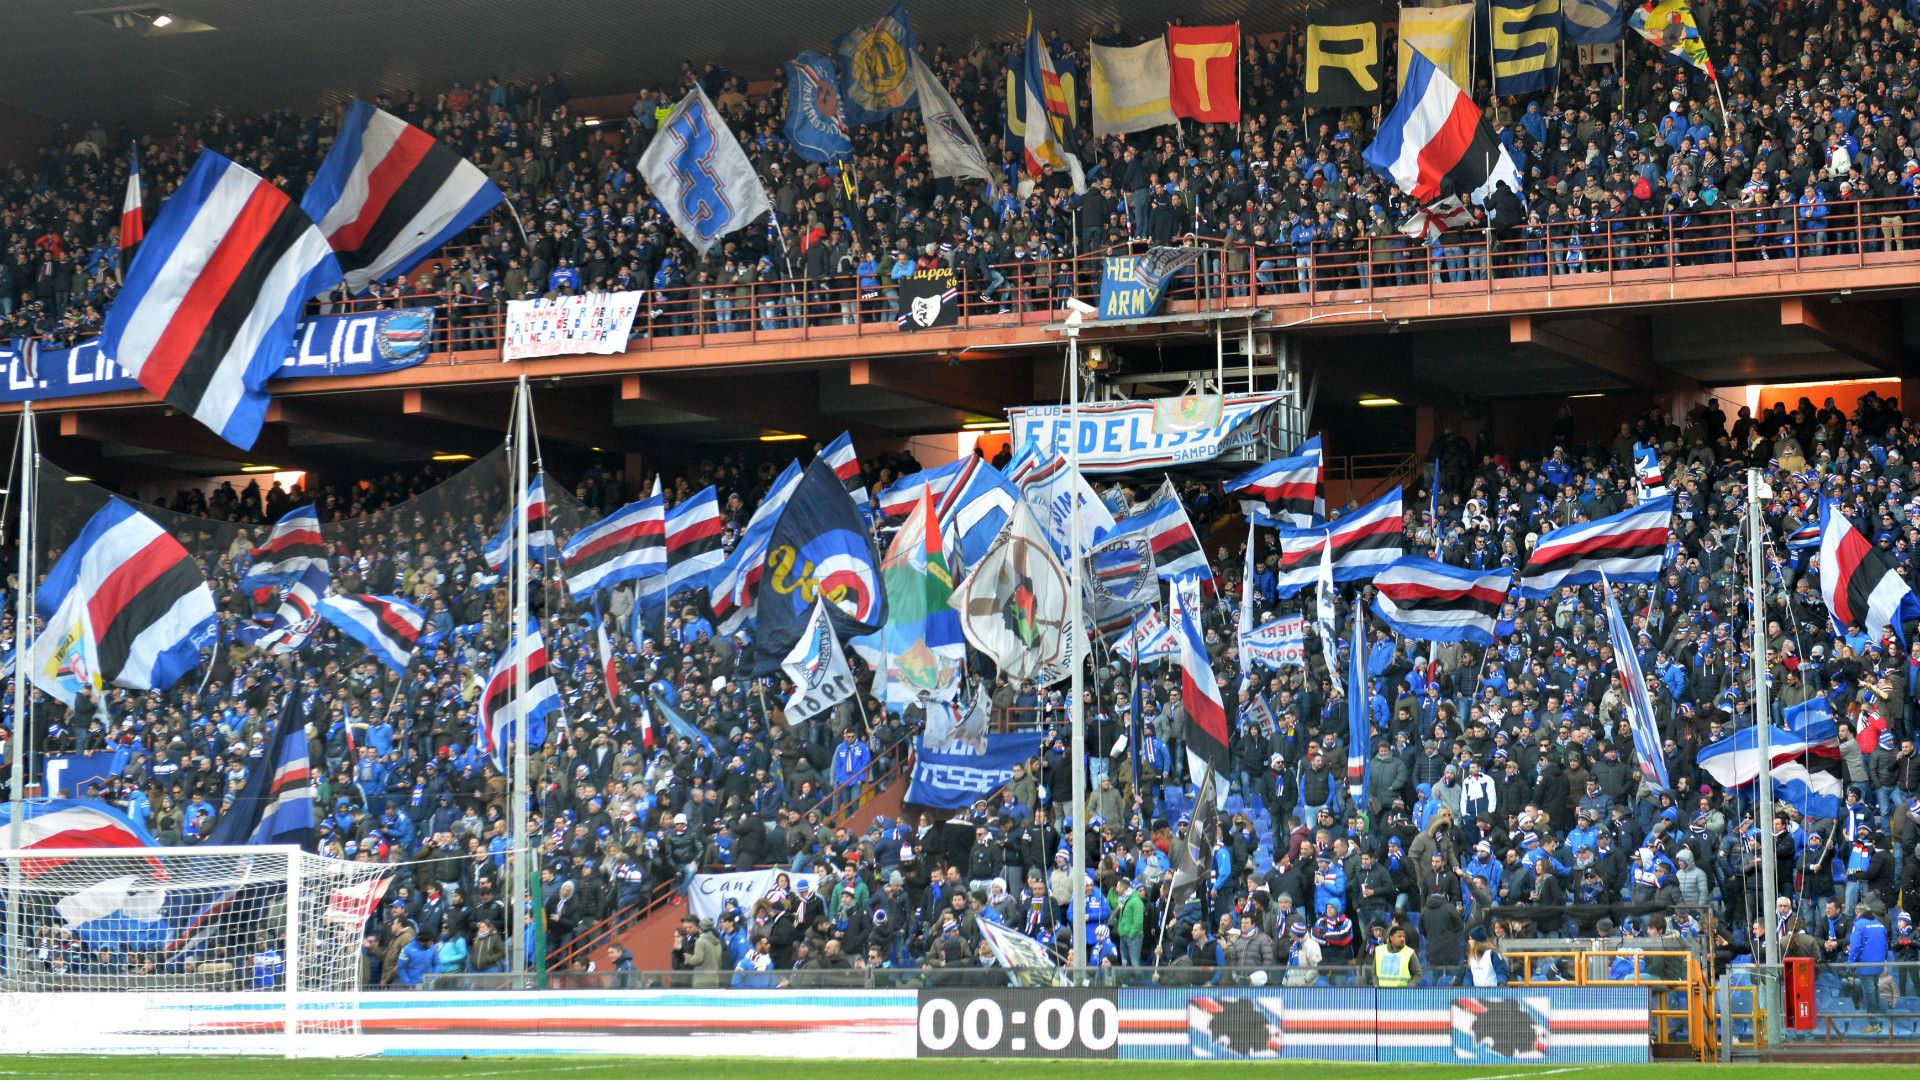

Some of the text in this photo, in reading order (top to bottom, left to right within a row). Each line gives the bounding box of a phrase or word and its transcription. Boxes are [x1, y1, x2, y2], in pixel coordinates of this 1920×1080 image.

[946, 276, 958, 289] 86
[1107, 288, 1159, 316] ARMY
[1026, 407, 1060, 417] CLUB
[700, 877, 753, 895] Cani
[919, 998, 1119, 1050] 00:00
